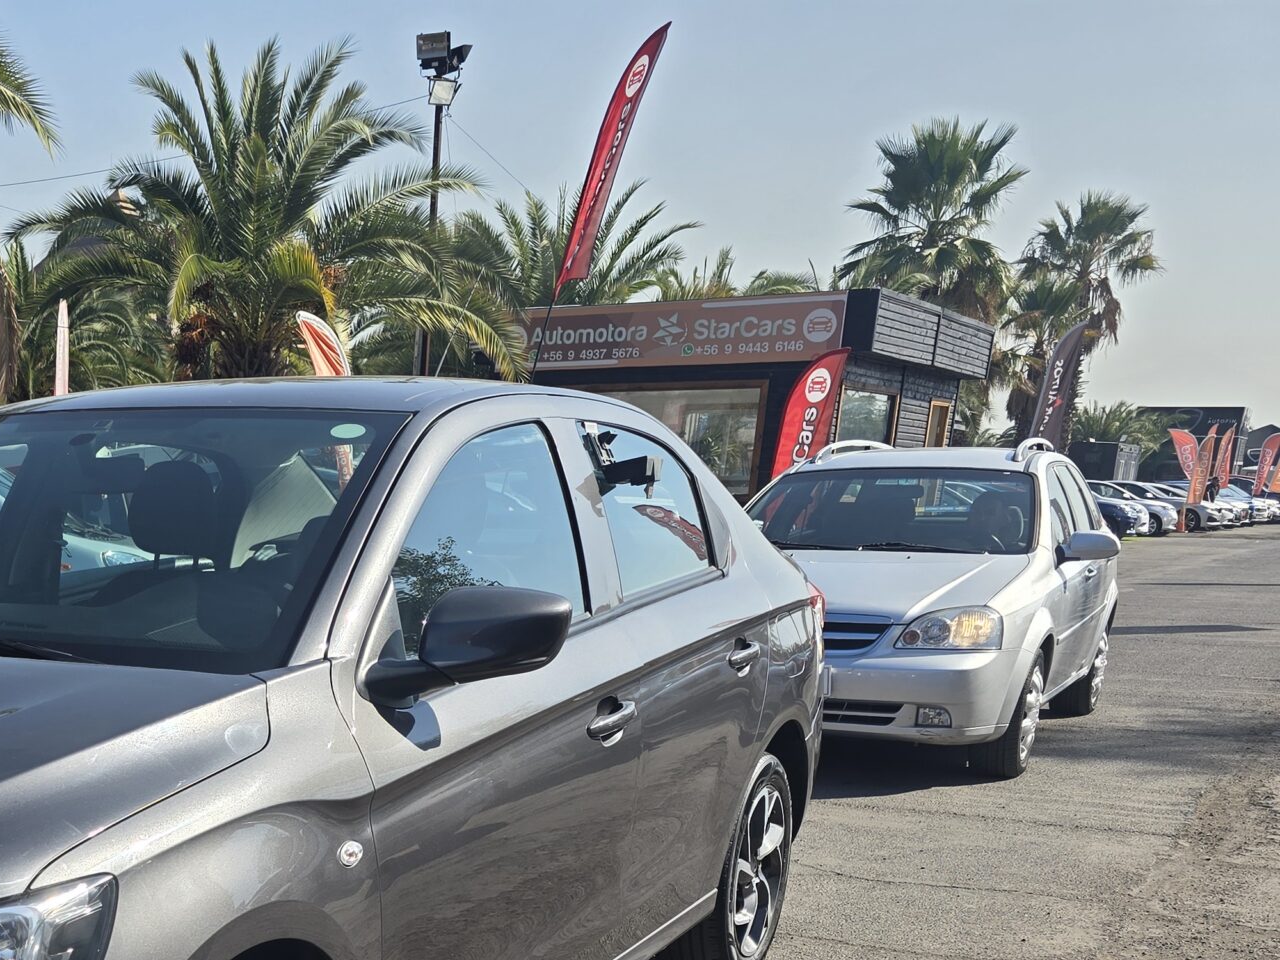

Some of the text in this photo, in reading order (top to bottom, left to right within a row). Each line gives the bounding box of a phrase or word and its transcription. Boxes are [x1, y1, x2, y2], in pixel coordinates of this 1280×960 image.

[530, 316, 796, 346] Automotora StarCars
[542, 347, 640, 361] +56 9 4937 5676
[696, 340, 804, 356] +56 9 9443 6146
[792, 406, 817, 463] Cars
